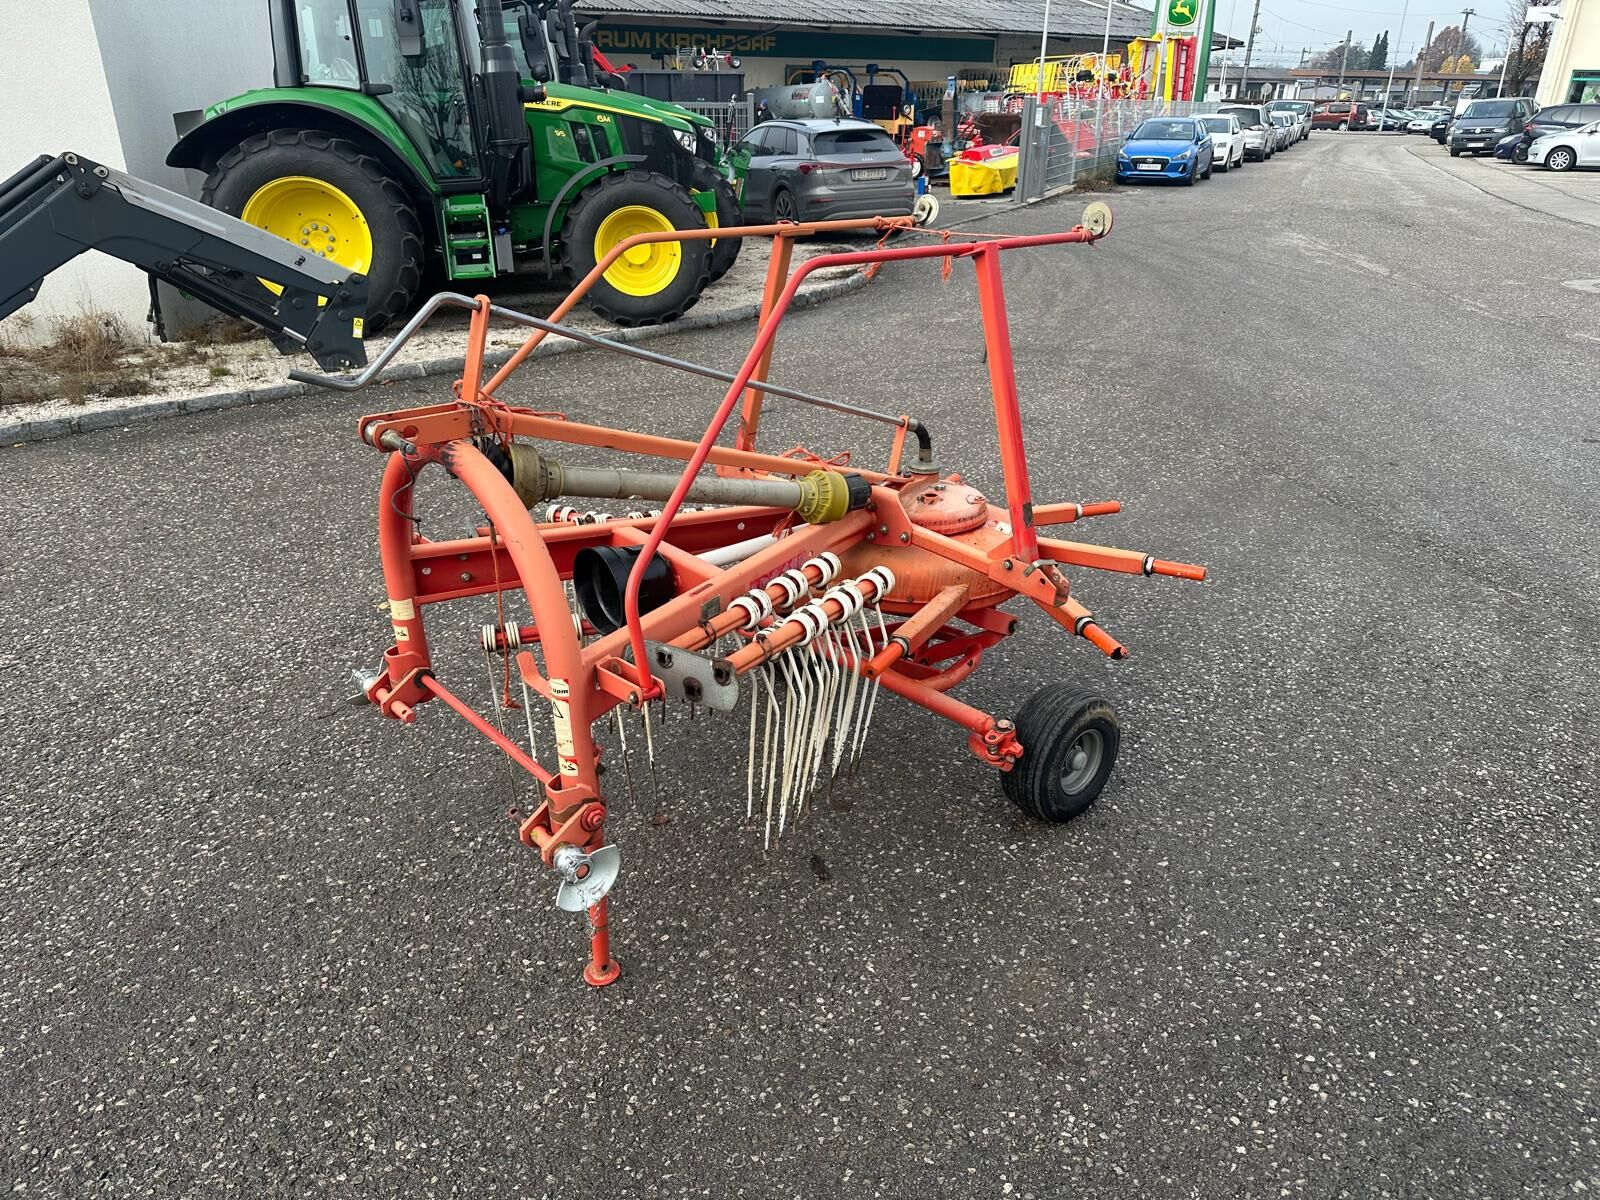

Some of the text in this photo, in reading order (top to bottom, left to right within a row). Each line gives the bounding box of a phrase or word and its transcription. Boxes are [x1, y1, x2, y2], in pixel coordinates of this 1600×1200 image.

[592, 30, 776, 51] RUM KIRCHDORF
[597, 115, 611, 123] 6M
[554, 129, 566, 138] 95
